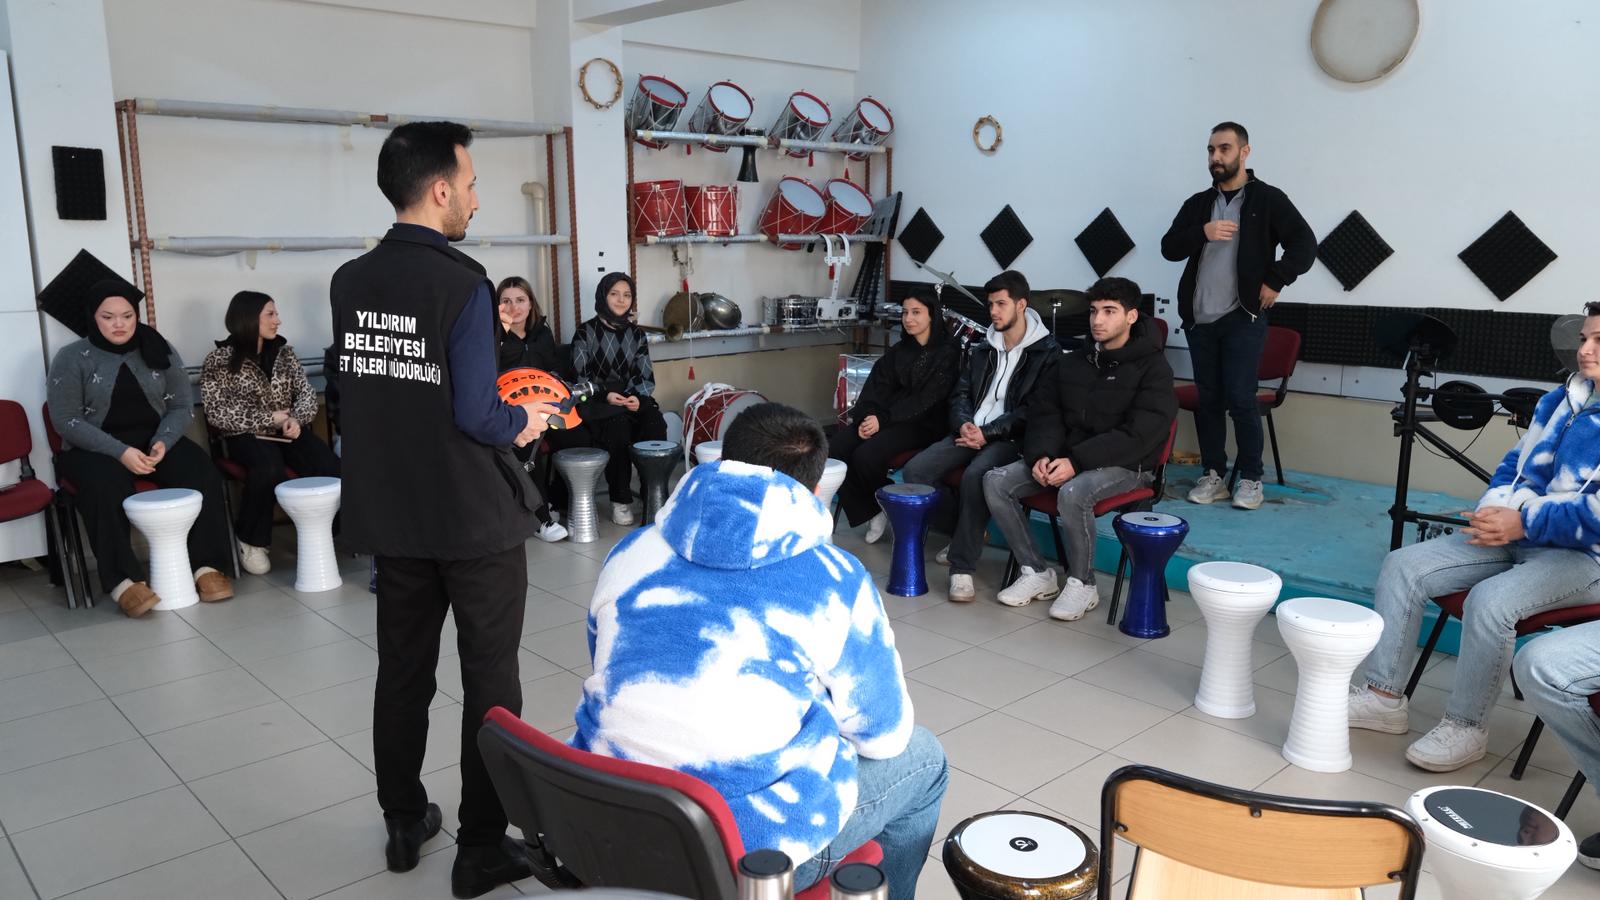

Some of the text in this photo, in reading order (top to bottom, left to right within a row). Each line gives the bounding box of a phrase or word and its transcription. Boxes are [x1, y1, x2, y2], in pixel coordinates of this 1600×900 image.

[356, 310, 417, 334] YILDIRIM
[344, 332, 426, 359] BELEDİYESİ
[353, 352, 387, 377] İŞLERİ
